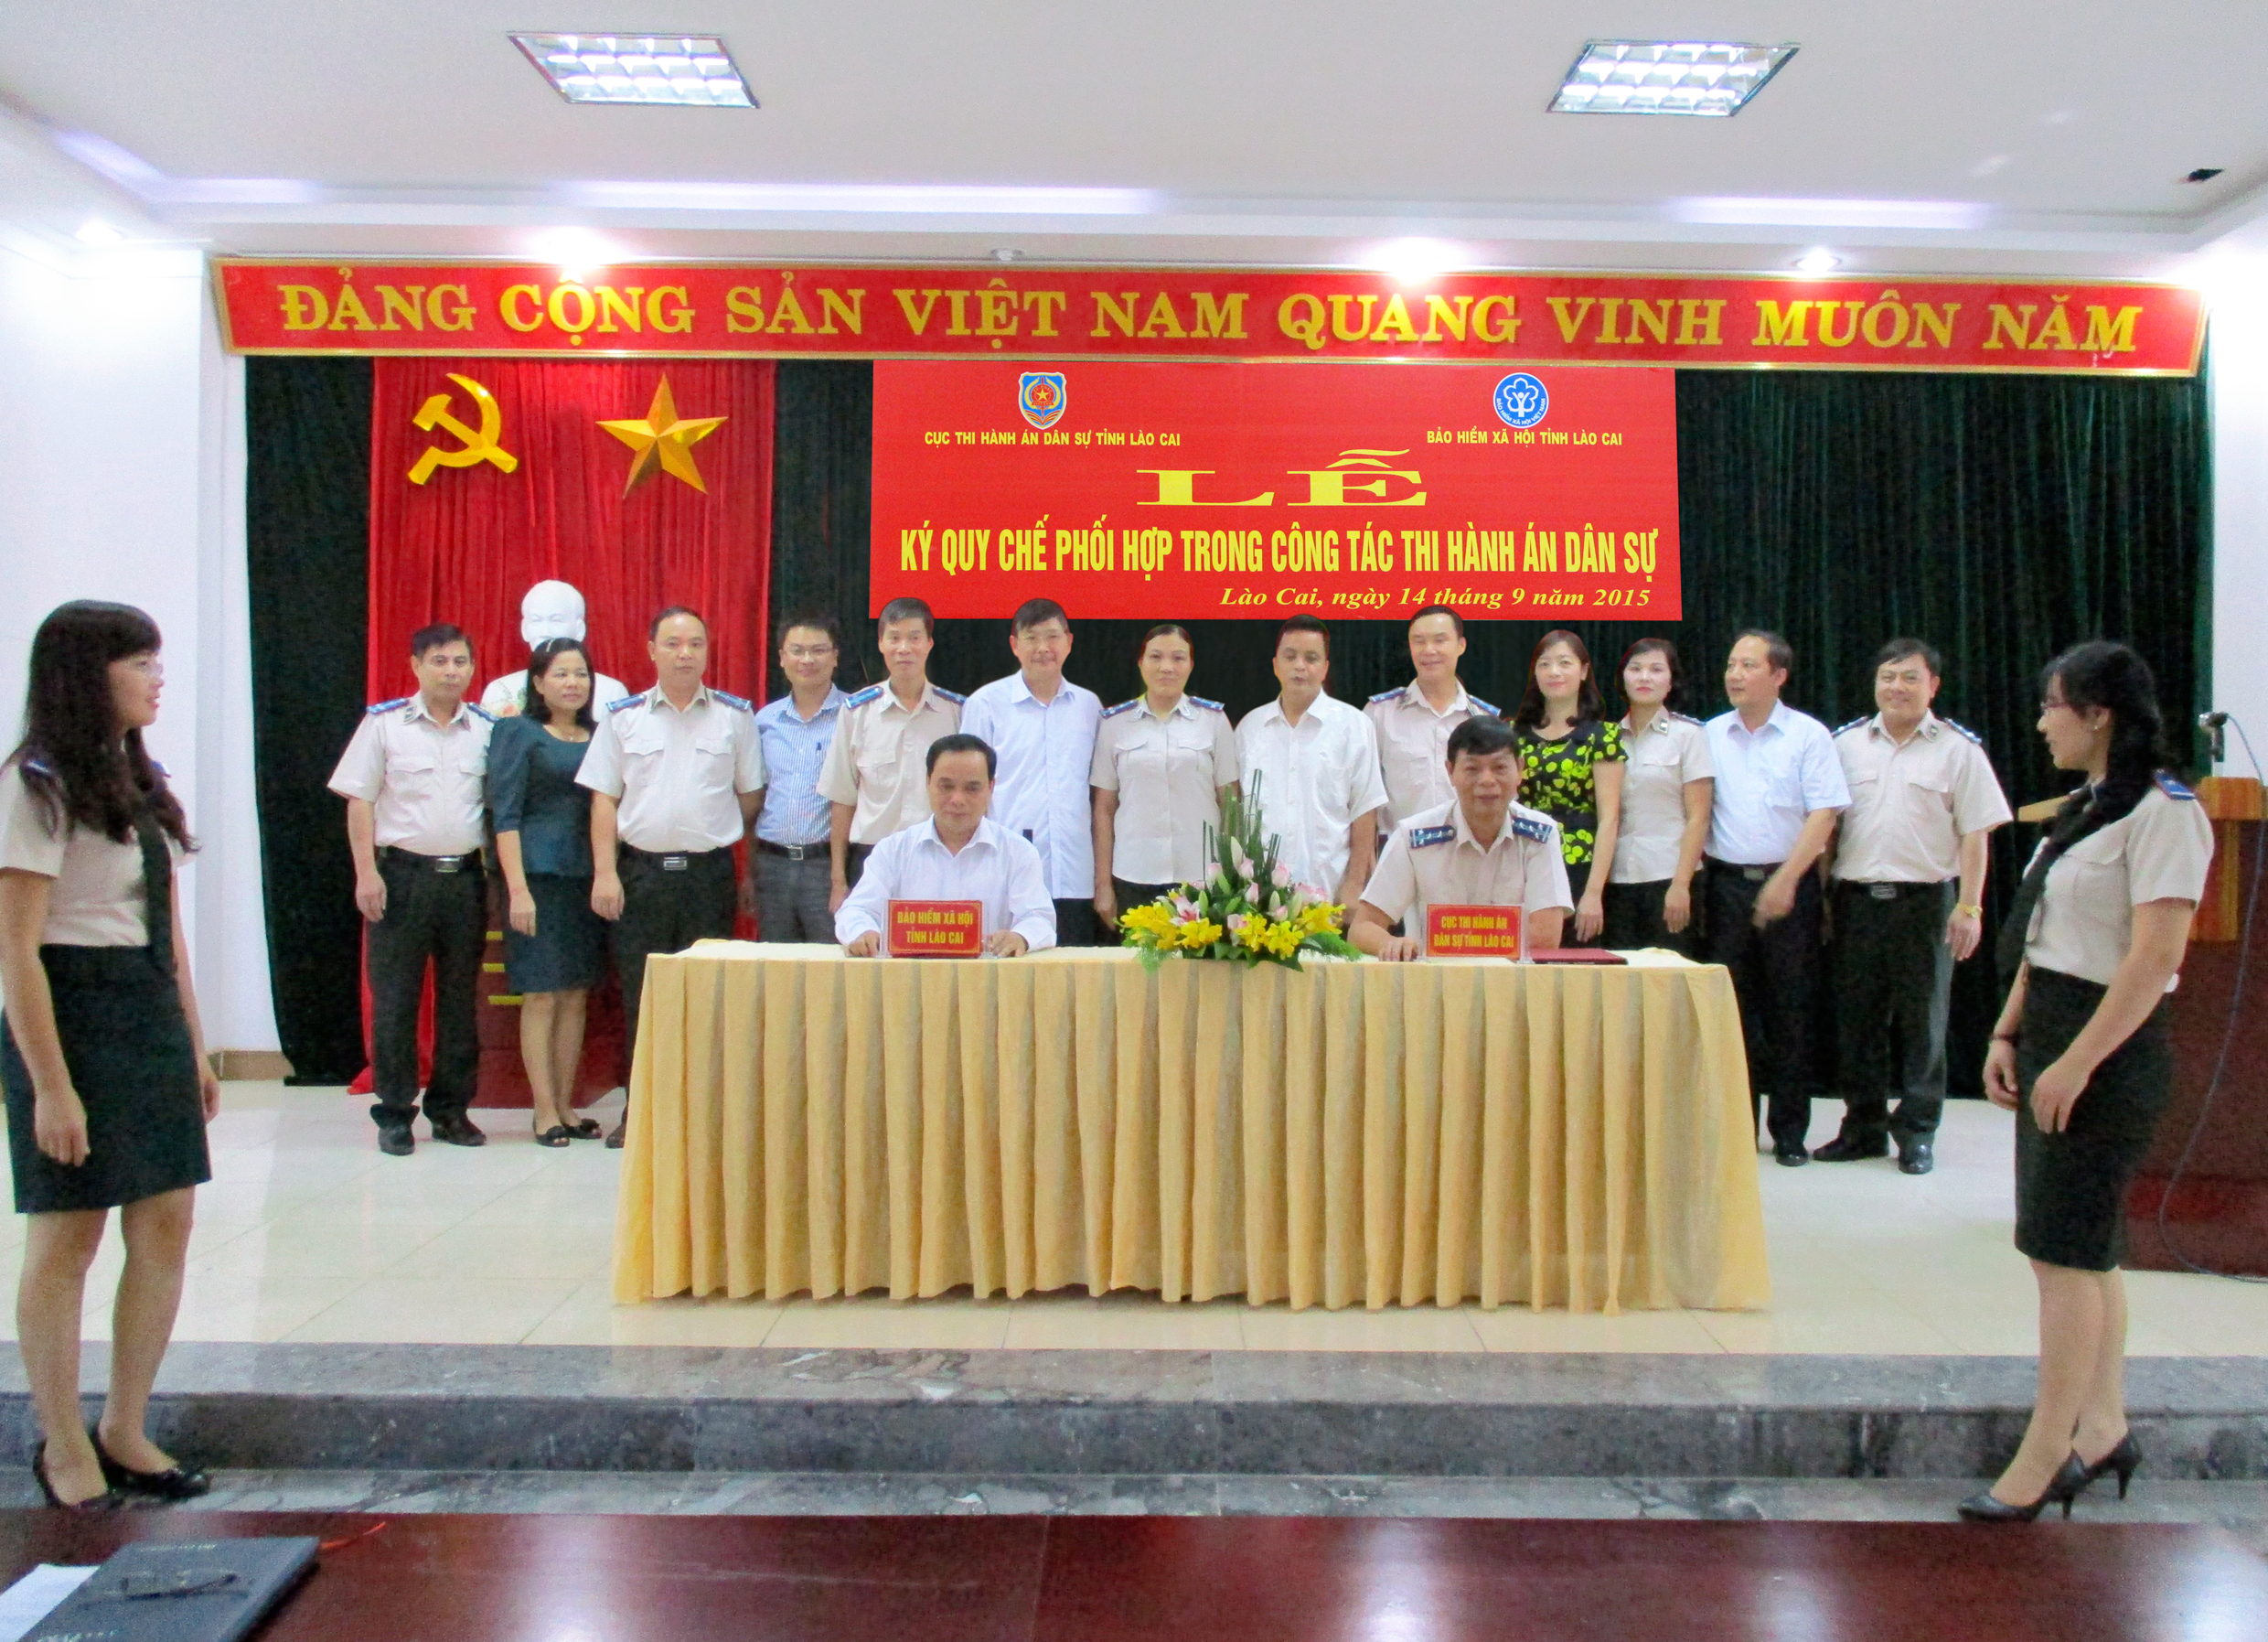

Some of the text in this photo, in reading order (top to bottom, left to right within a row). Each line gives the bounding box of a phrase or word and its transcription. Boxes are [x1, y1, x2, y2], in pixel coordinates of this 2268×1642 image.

[277, 267, 2144, 352] ĐẢNG CỘNG SẢN VIỆT NAM QUANG VINH MUÔN NĂM
[925, 428, 1181, 449] CỤC THI HÀNH ÁN DÂN SỰ TỈNH LÀO CAI
[1427, 425, 1622, 448] BẢO HIỂM XÃ HỘI TỈNH LÀO CAI
[1136, 448, 1428, 507] LỄ
[901, 514, 1659, 583] KÝ QUY CHẾ PHỐI HỢP TRONG CÔNG TÁC THI HÀNH ÁN DÂN SỰ
[1219, 588, 1651, 609] Lào Cai, ngày 14 tháng 9 năm 2015
[897, 906, 973, 928] BẢO HIỂM XÃ HỘI
[906, 927, 964, 944] TỈNH LÀO CAI
